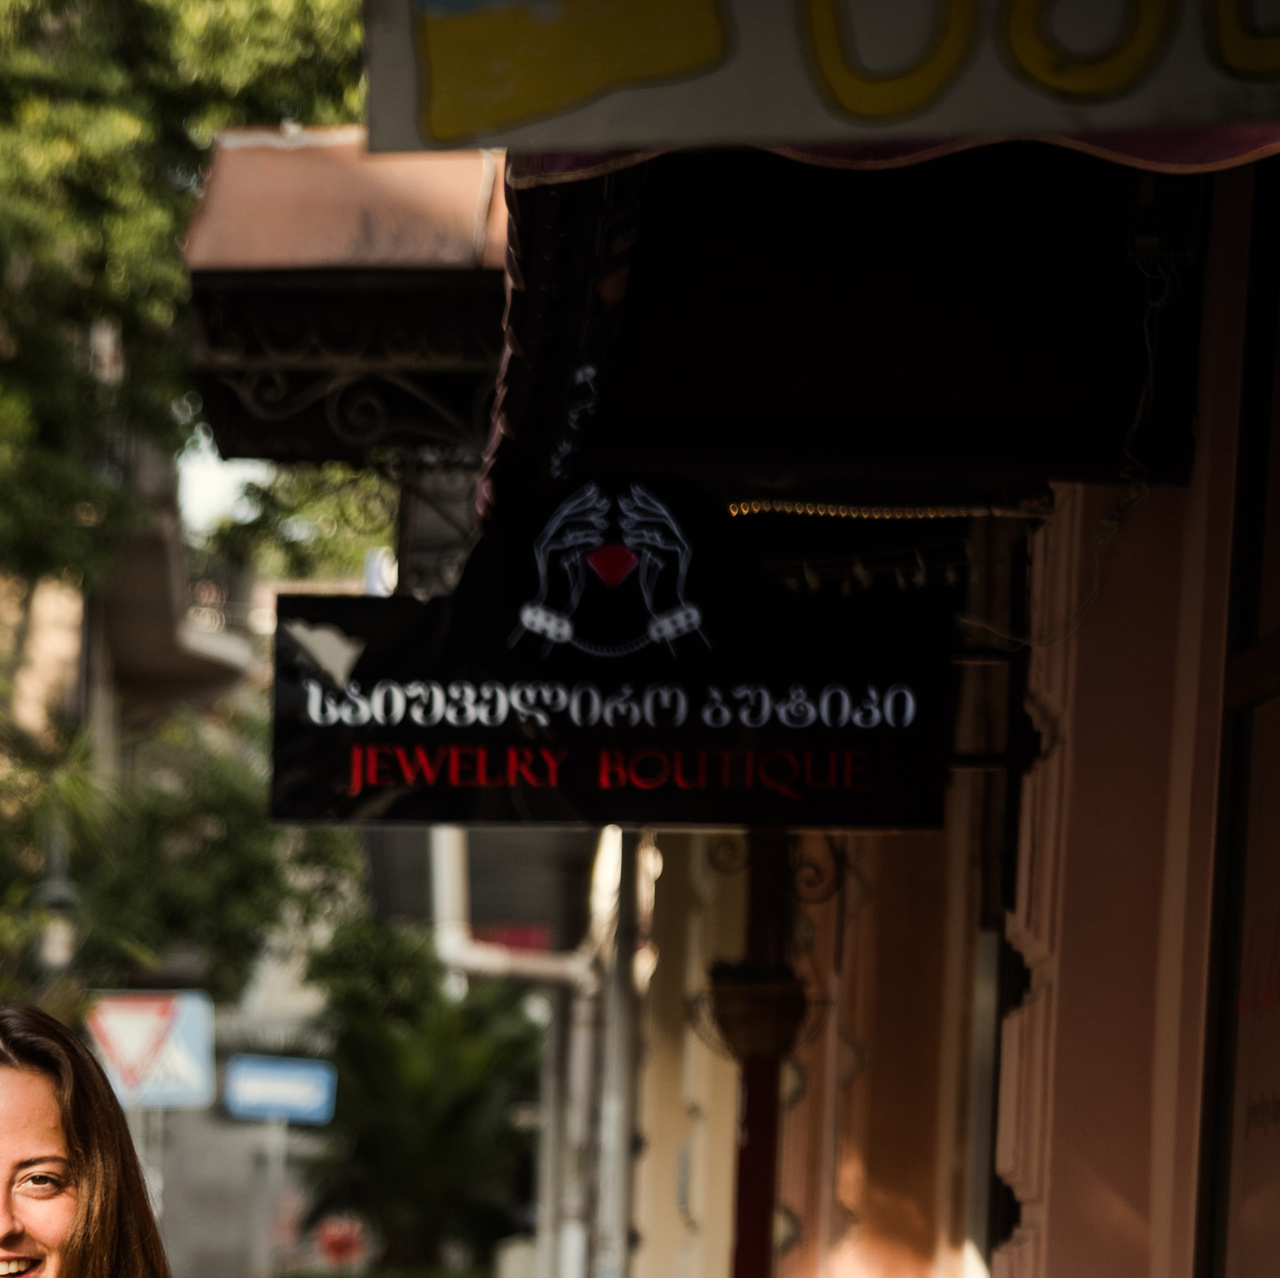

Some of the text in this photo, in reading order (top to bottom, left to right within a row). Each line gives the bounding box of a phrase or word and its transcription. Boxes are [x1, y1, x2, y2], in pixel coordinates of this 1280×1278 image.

[304, 678, 918, 728] საიუველირო ბუტიკი
[346, 743, 871, 797] JEWELRY BOUTIQUE
